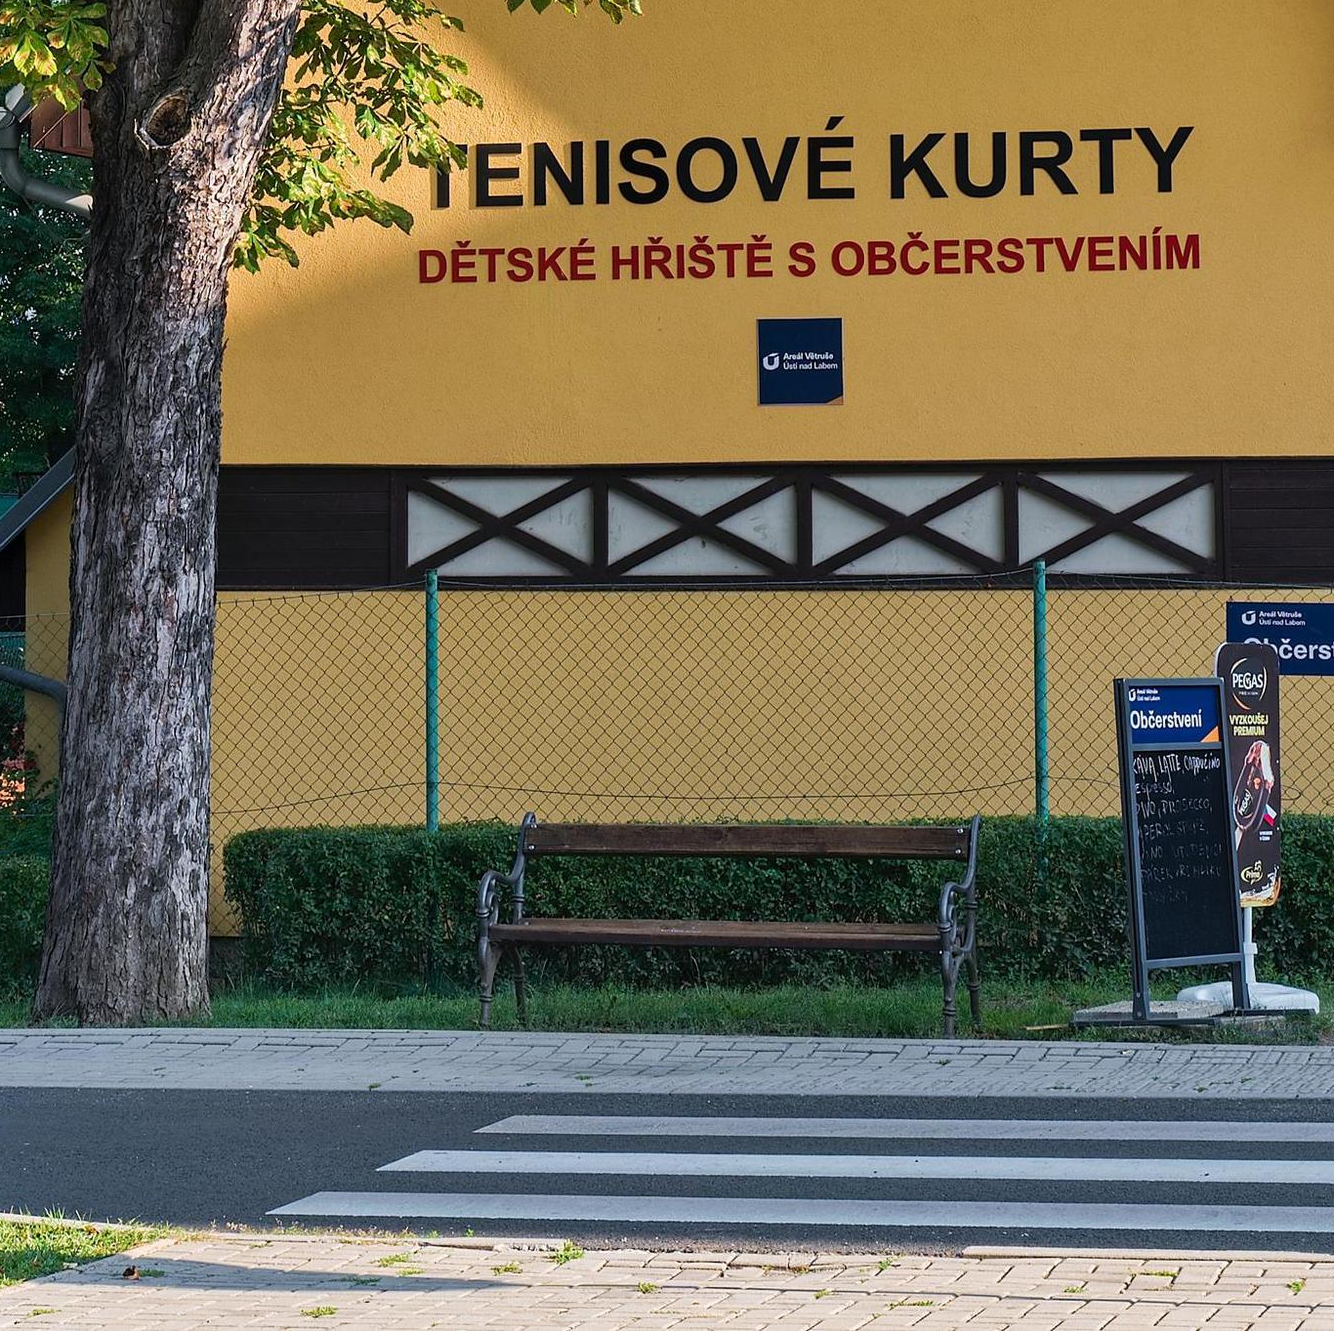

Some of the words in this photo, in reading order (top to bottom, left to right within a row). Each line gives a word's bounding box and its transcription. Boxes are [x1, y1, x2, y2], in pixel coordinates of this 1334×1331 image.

[422, 116, 855, 208] TENISOVÉ
[890, 126, 1195, 200] KURTY
[419, 237, 596, 284] DĚTSKÉ
[611, 234, 774, 281] HŘIŠTĚ
[788, 241, 816, 278] S
[831, 225, 1200, 277] OBČERSTVENÍM
[783, 352, 803, 360] Areál
[799, 362, 812, 370] nad
[814, 361, 838, 370] Labem
[1232, 672, 1264, 690] PEGAS
[1130, 708, 1203, 730] Občerstvení
[1229, 712, 1269, 725] VYZKOUŠEJ
[1233, 726, 1265, 736] PREMIUM
